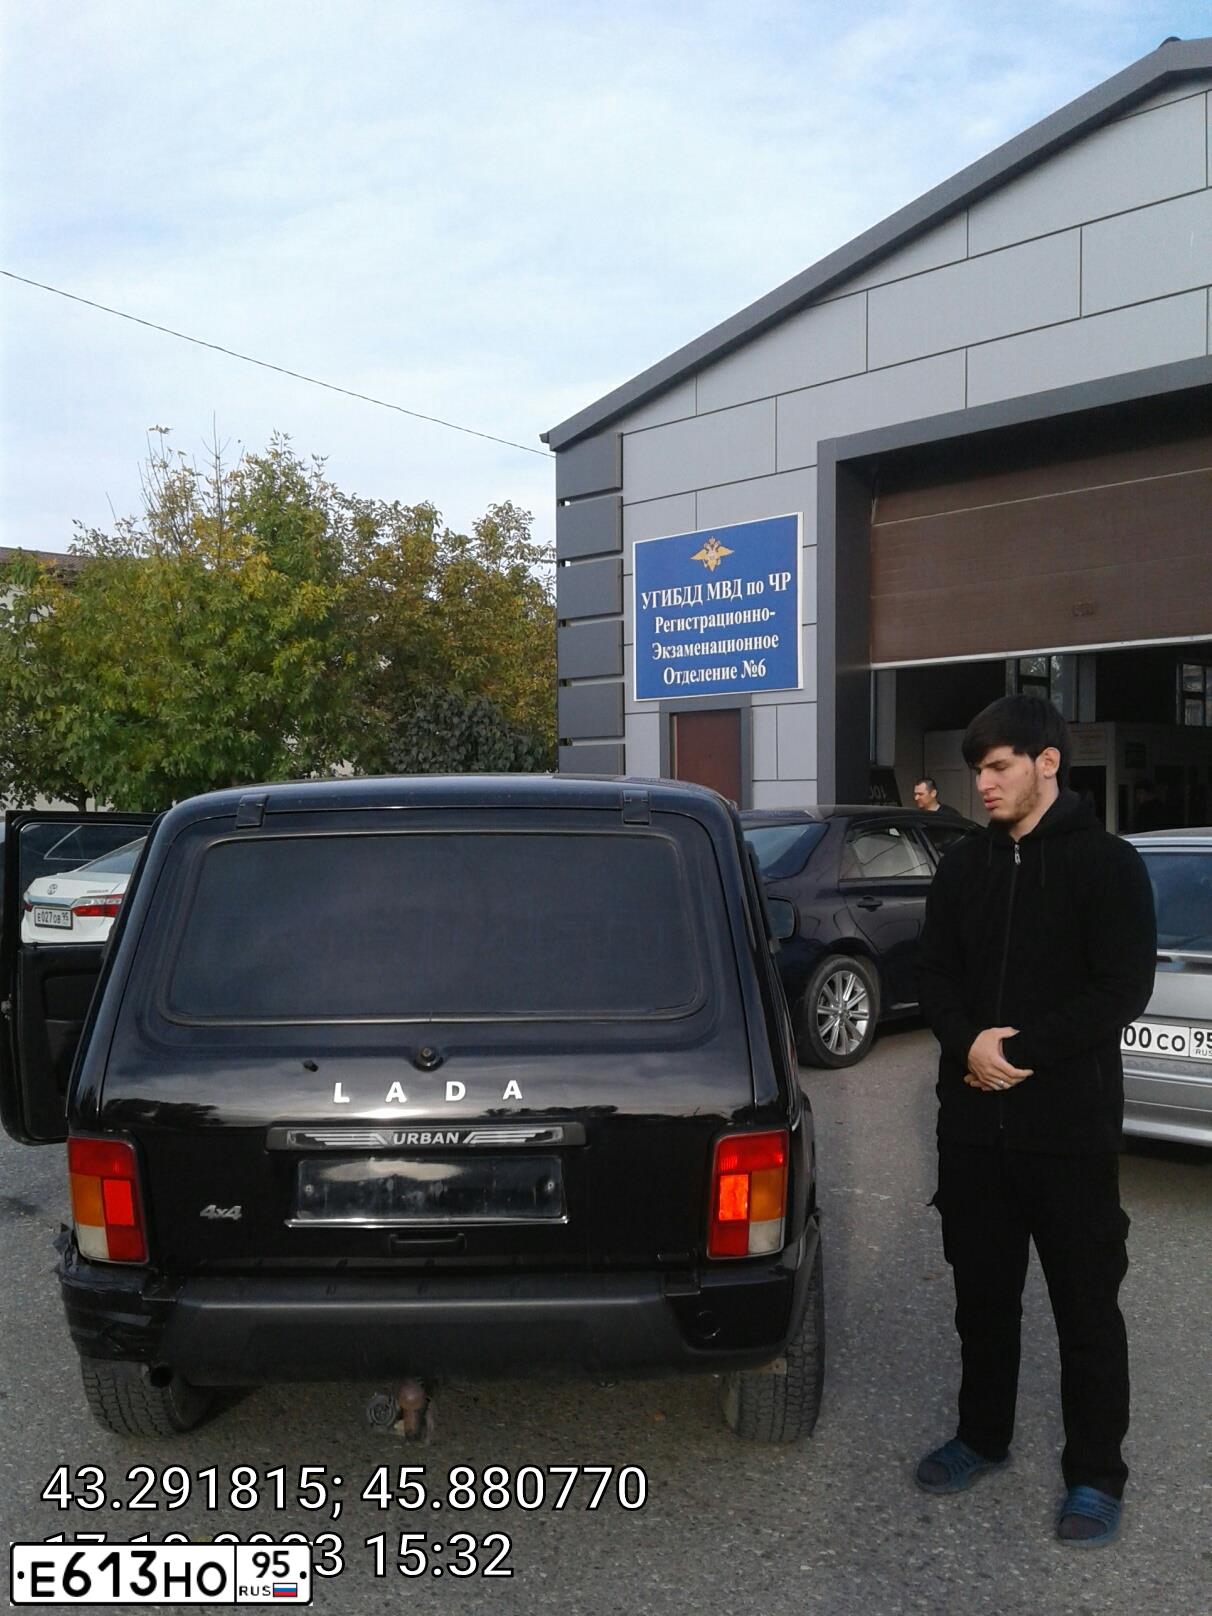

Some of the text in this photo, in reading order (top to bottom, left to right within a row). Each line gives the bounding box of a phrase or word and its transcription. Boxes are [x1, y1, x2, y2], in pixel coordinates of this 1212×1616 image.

[641, 571, 792, 610] УГИБДД МВД по ЧР
[655, 606, 776, 634] Регистрационно-
[652, 634, 779, 660] Экзаменационное
[663, 658, 767, 686] Отделение №6
[333, 1080, 523, 1103] LADA
[393, 1131, 460, 1145] URBAN
[200, 1204, 243, 1220] 4x4
